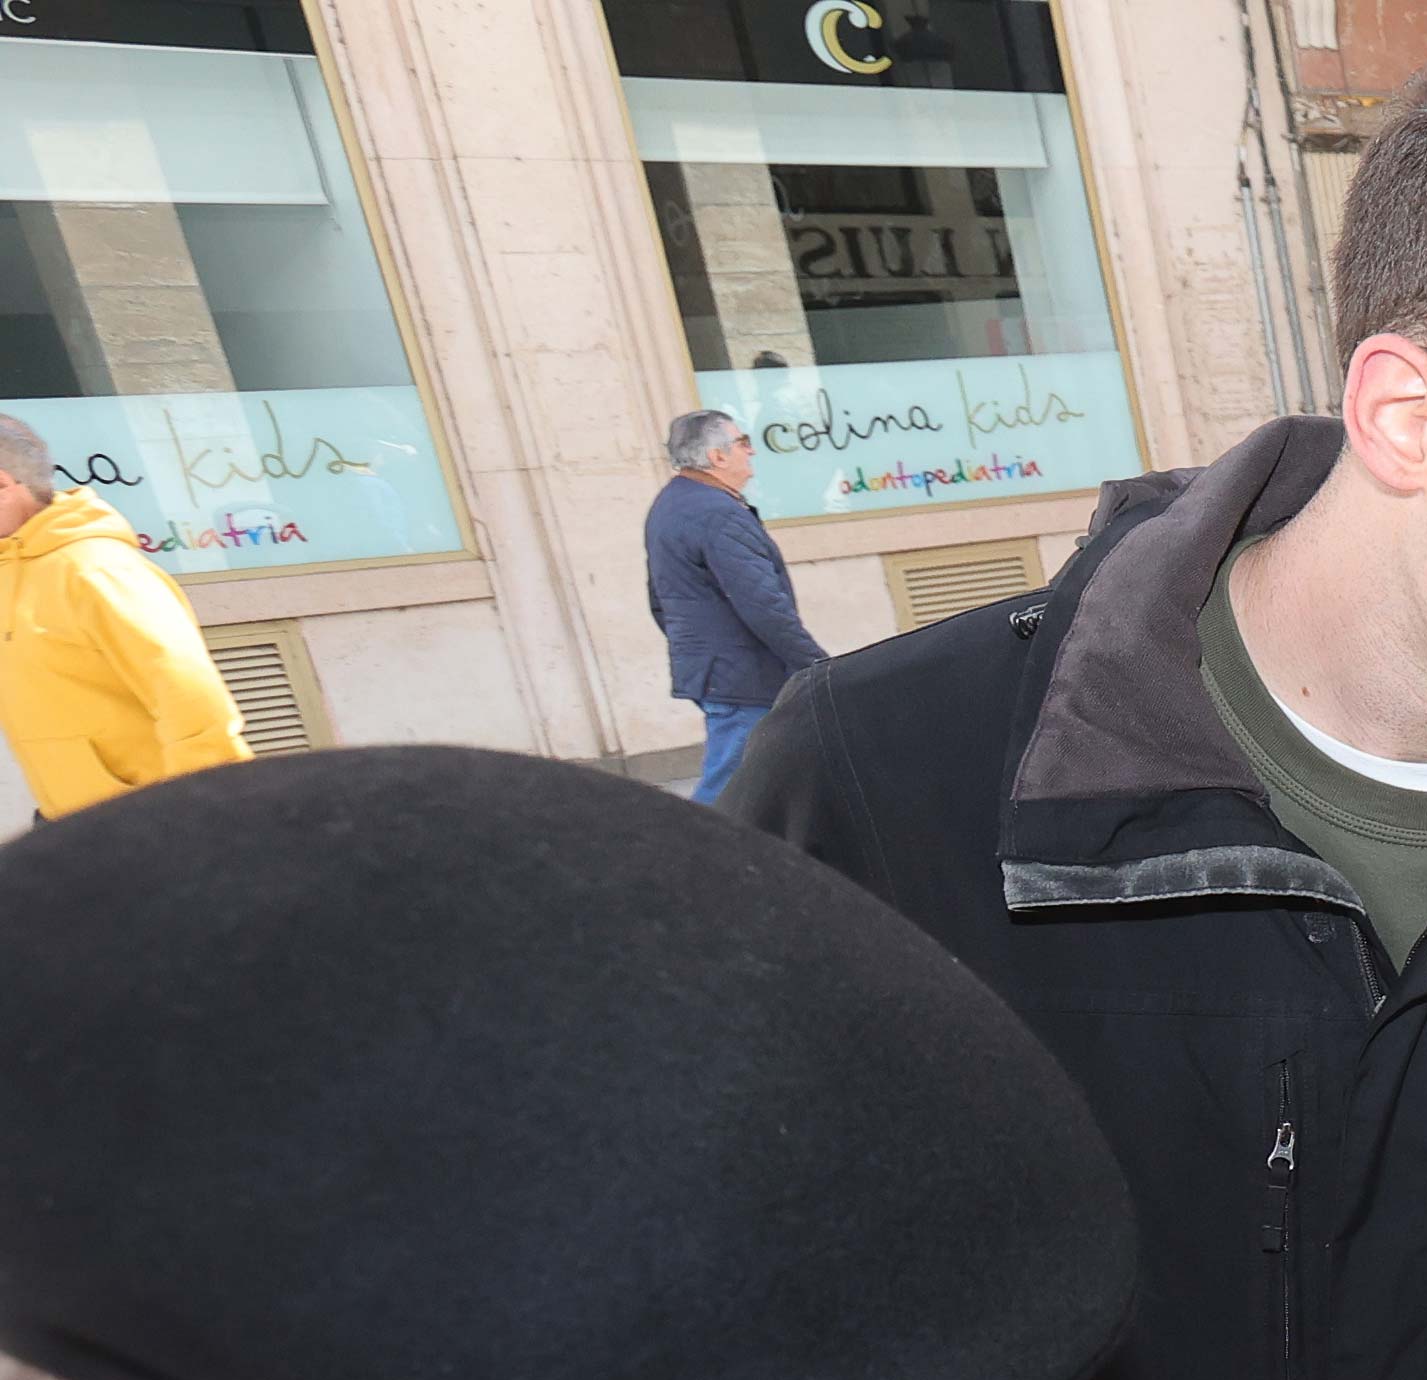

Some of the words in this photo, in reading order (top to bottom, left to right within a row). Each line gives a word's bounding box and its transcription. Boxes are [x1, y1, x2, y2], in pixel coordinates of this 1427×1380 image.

[163, 400, 370, 508] kids
[763, 387, 943, 454] colina
[956, 363, 1086, 449] kids
[839, 454, 1043, 497] odontopediatria
